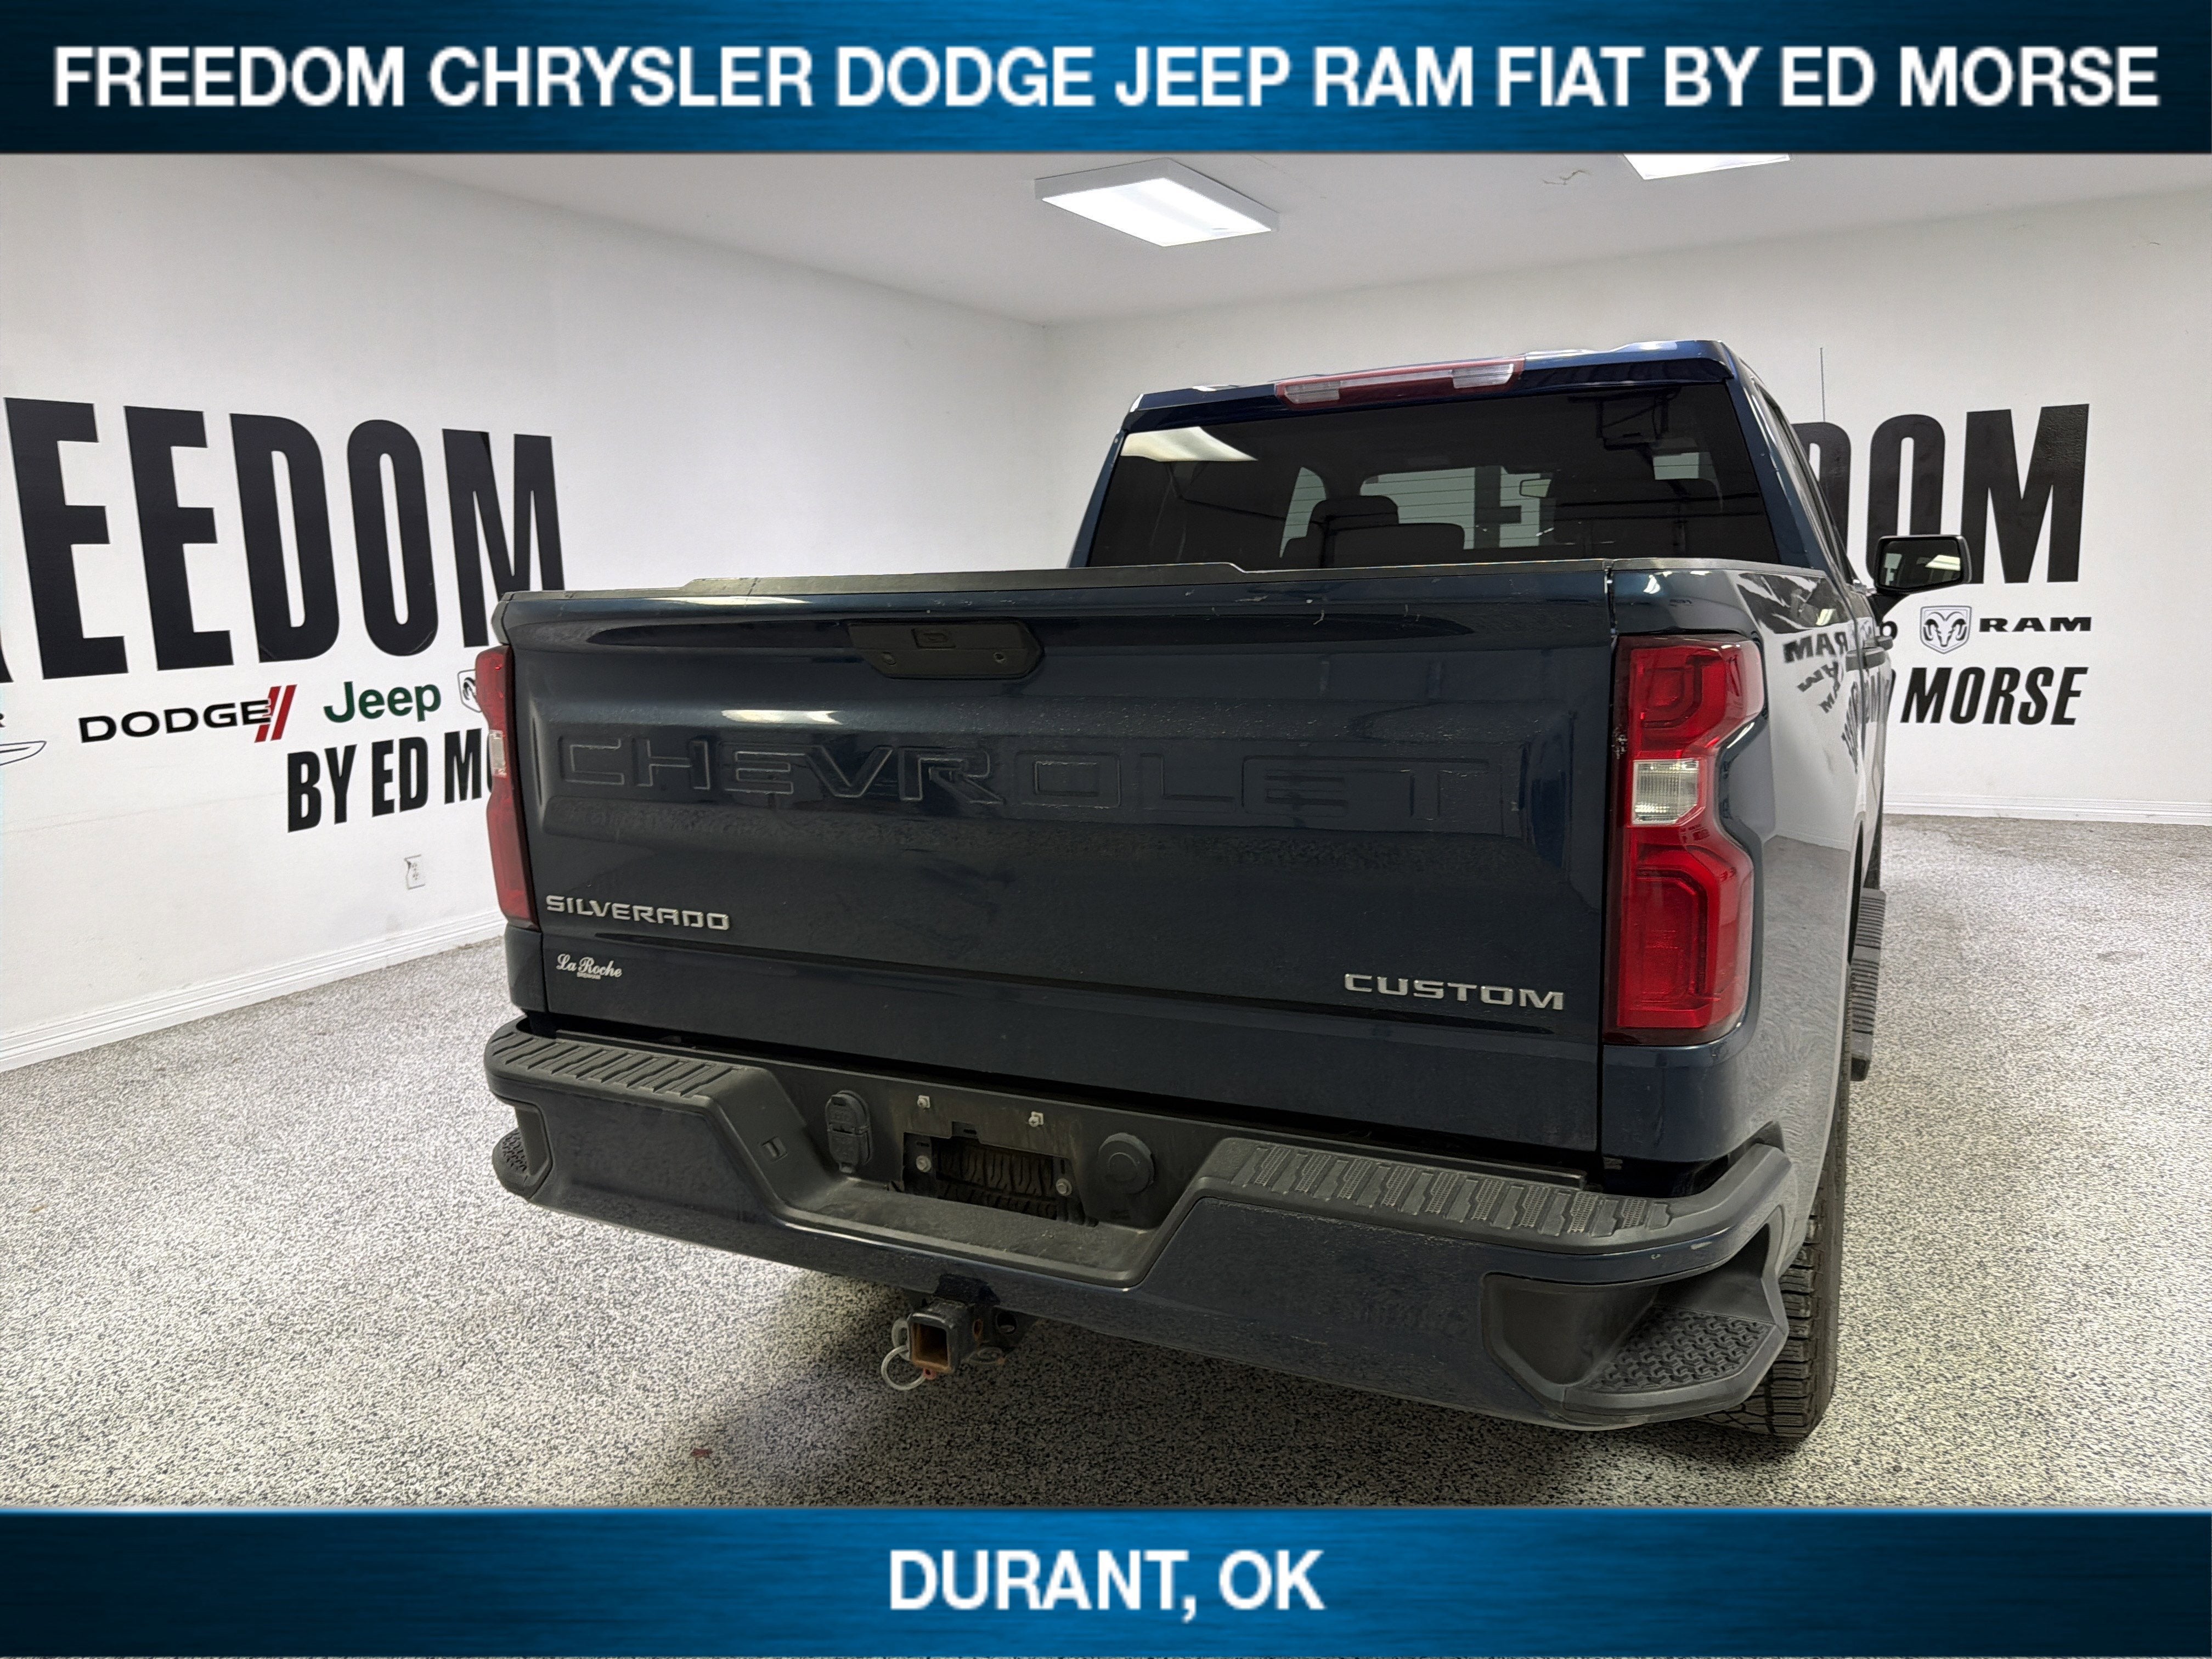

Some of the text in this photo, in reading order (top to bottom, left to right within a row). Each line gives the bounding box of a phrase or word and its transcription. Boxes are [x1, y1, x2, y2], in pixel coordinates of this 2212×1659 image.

[0, 397, 565, 682] EEDOM
[1979, 617, 2092, 633] RAM
[323, 681, 441, 723] Jeep
[1900, 667, 2089, 726] MORSE
[78, 699, 272, 743] DODGE
[287, 727, 492, 833] BY ED M
[557, 734, 1491, 820] CHEVROLET
[545, 895, 731, 931] SILVERADO
[556, 953, 577, 972] La
[578, 956, 623, 978] Roche
[1344, 973, 1565, 1010] CUSTOM
